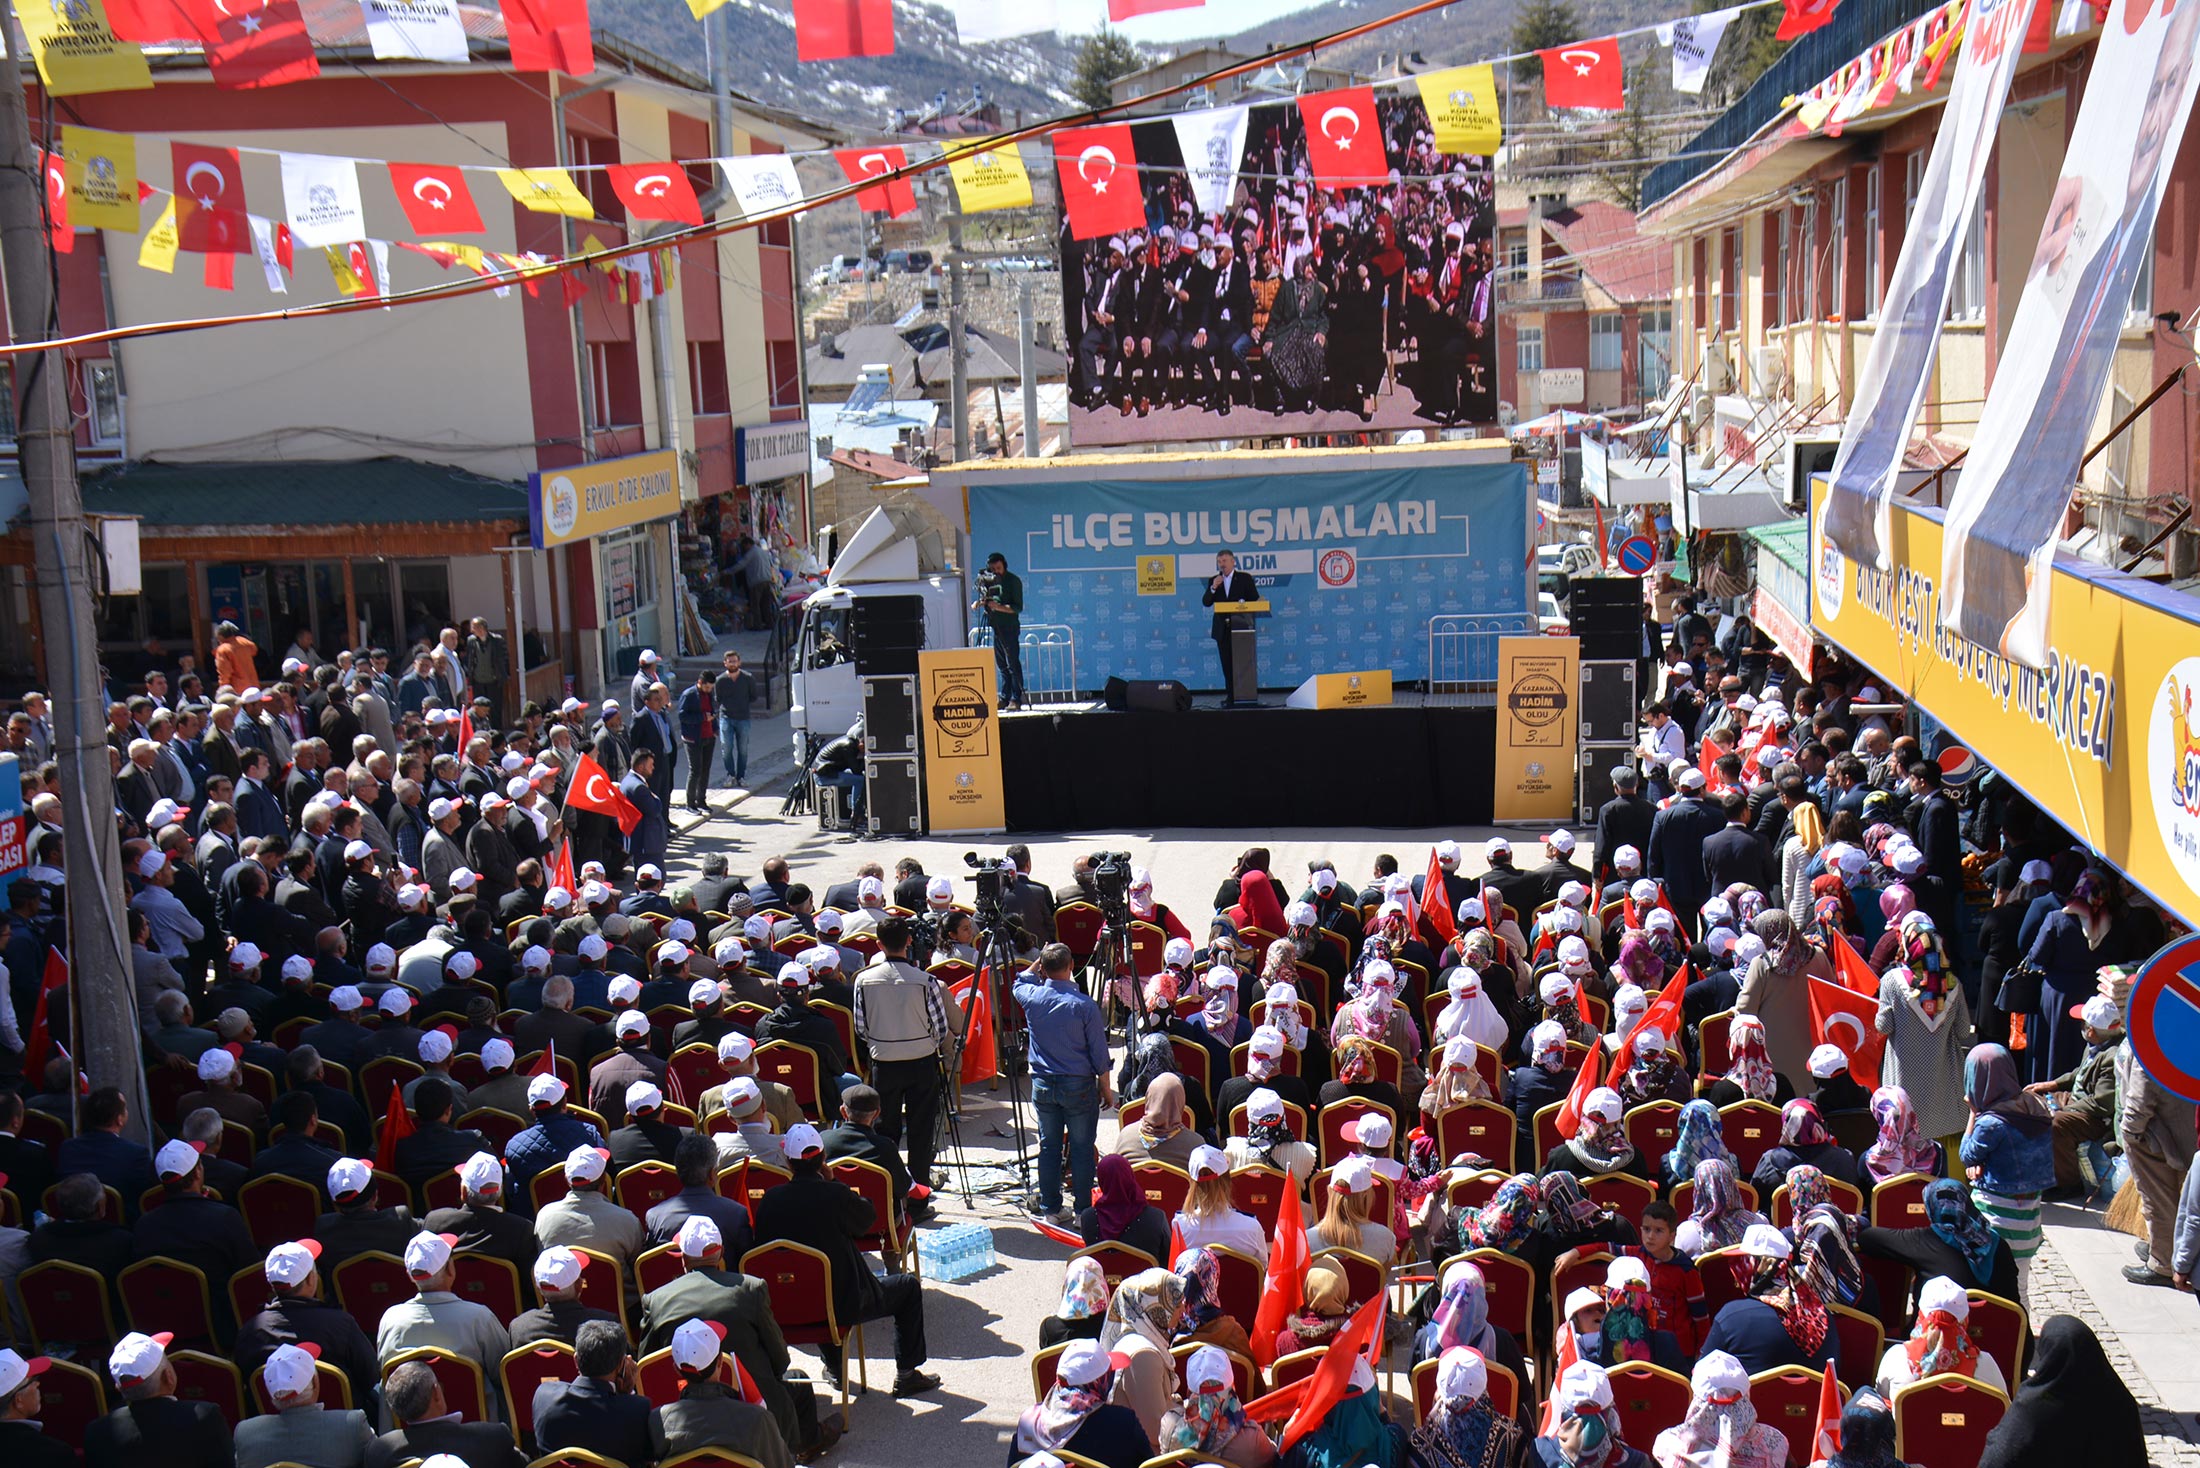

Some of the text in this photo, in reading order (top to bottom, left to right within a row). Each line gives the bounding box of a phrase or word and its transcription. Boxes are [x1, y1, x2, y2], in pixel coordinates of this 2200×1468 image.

[1437, 115, 1494, 125] BÜYÜKŞEHİR
[974, 167, 1004, 175] KONYA
[962, 173, 1020, 184] BÜYÜKŞEHİR
[585, 482, 616, 513] ERKUL
[640, 468, 671, 500] SALONU
[1052, 499, 1437, 552] İLÇE BULUŞMALARI
[1254, 576, 1276, 586] 2017
[1897, 565, 1933, 655] ÇEŞİT
[1520, 695, 1554, 707] HADİM
[943, 706, 976, 718] HADİM
[950, 721, 972, 729] OLDU
[949, 793, 983, 801] BÜYÜKŞEHİR
[0, 821, 17, 847] EP
